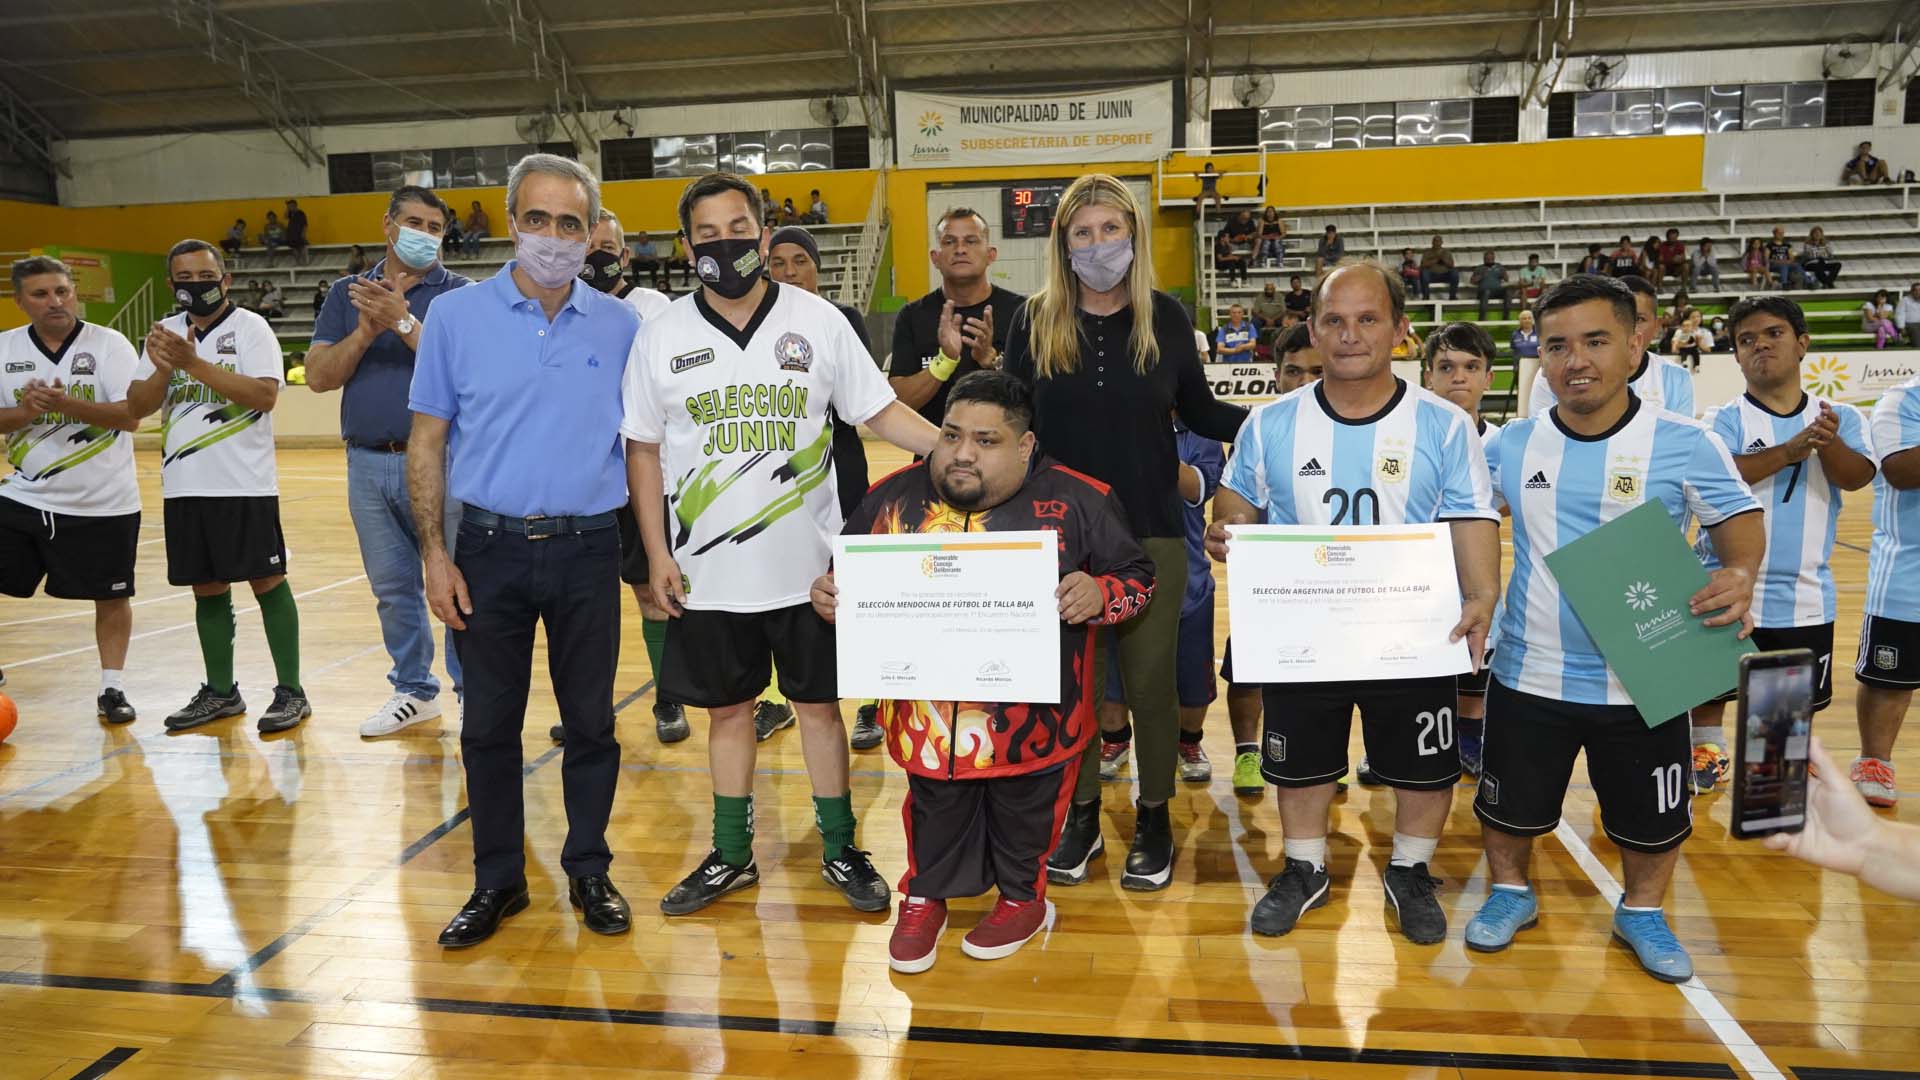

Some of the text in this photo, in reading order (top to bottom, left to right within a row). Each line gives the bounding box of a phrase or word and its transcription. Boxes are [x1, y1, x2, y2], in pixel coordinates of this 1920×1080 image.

[960, 100, 1133, 125] MUNICIPALIDAD DE JUNIN
[960, 133, 1153, 151] SUBSECRETARIA DE DEPORTE
[1015, 191, 1032, 205] 30
[685, 378, 809, 427] SELECCIÓN
[703, 420, 796, 457] JUNIN
[1298, 468, 1326, 477] adidas
[1524, 481, 1552, 489] adidas
[1322, 487, 1381, 526] 20
[1252, 586, 1291, 595] SELECCIÓN
[1412, 584, 1431, 594] BAJA
[857, 600, 895, 609] SELECCIÓN
[953, 599, 980, 608] FÚTBOL
[994, 600, 1015, 608] TALLA
[1017, 600, 1035, 609] BAJA
[1818, 652, 1831, 690] 7
[1415, 706, 1453, 756] 20
[1650, 762, 1682, 814] 10
